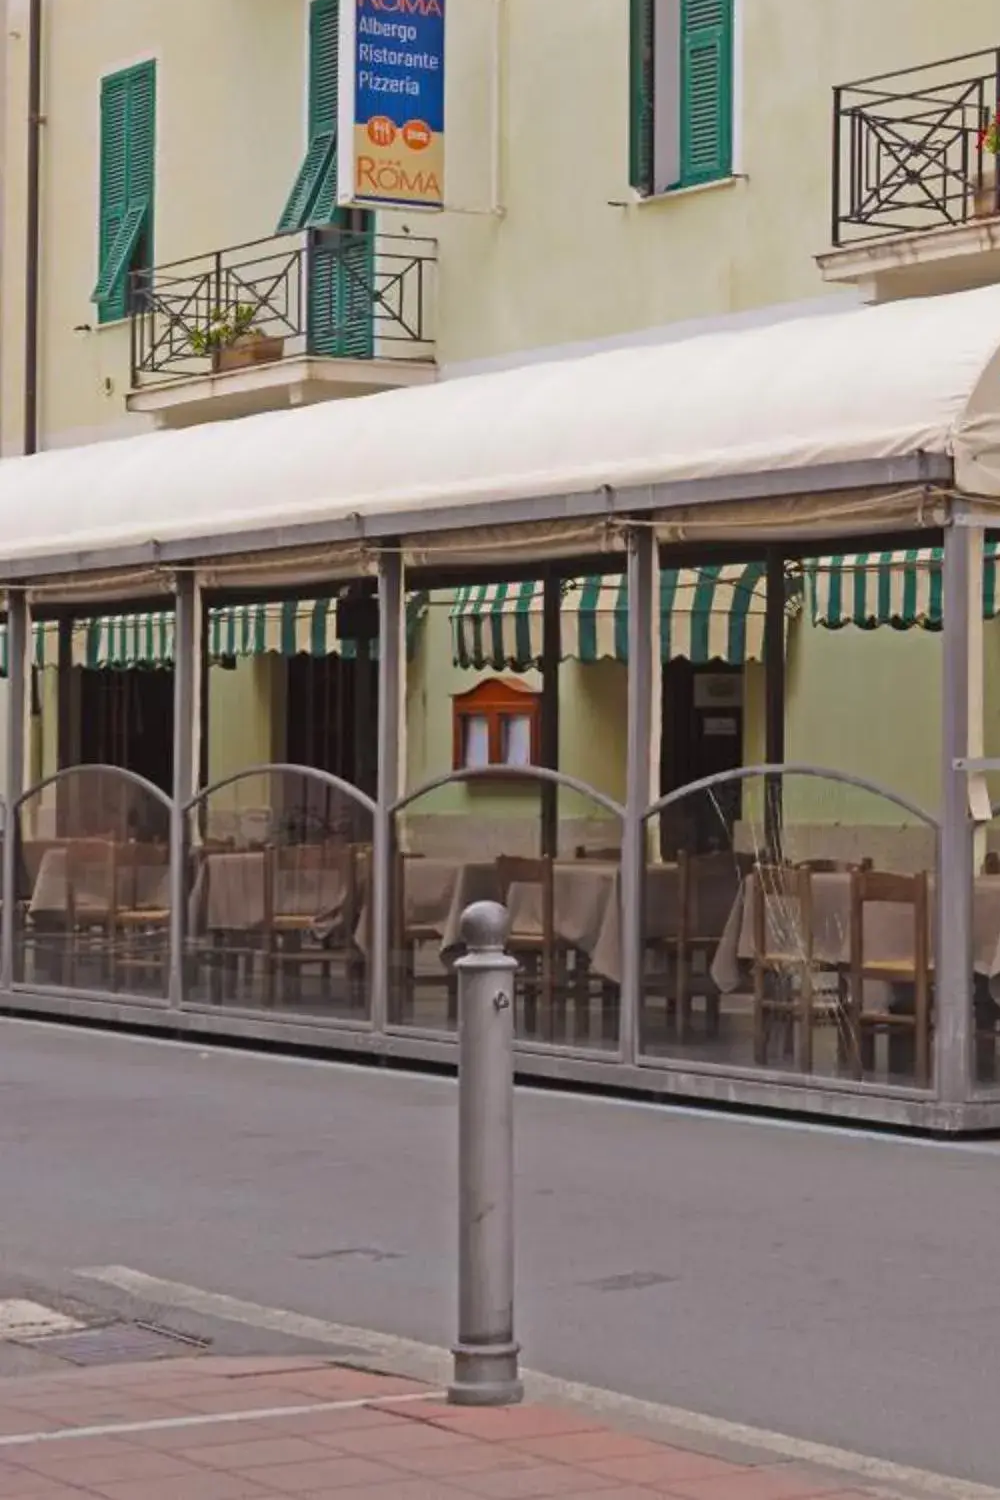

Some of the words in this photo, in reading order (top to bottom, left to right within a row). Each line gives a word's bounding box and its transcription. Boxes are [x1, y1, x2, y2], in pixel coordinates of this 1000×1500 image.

[359, 15, 417, 43] Albergo
[359, 43, 439, 69] Ristorante
[359, 70, 419, 96] Pizzeria
[357, 155, 441, 197] ROMA
